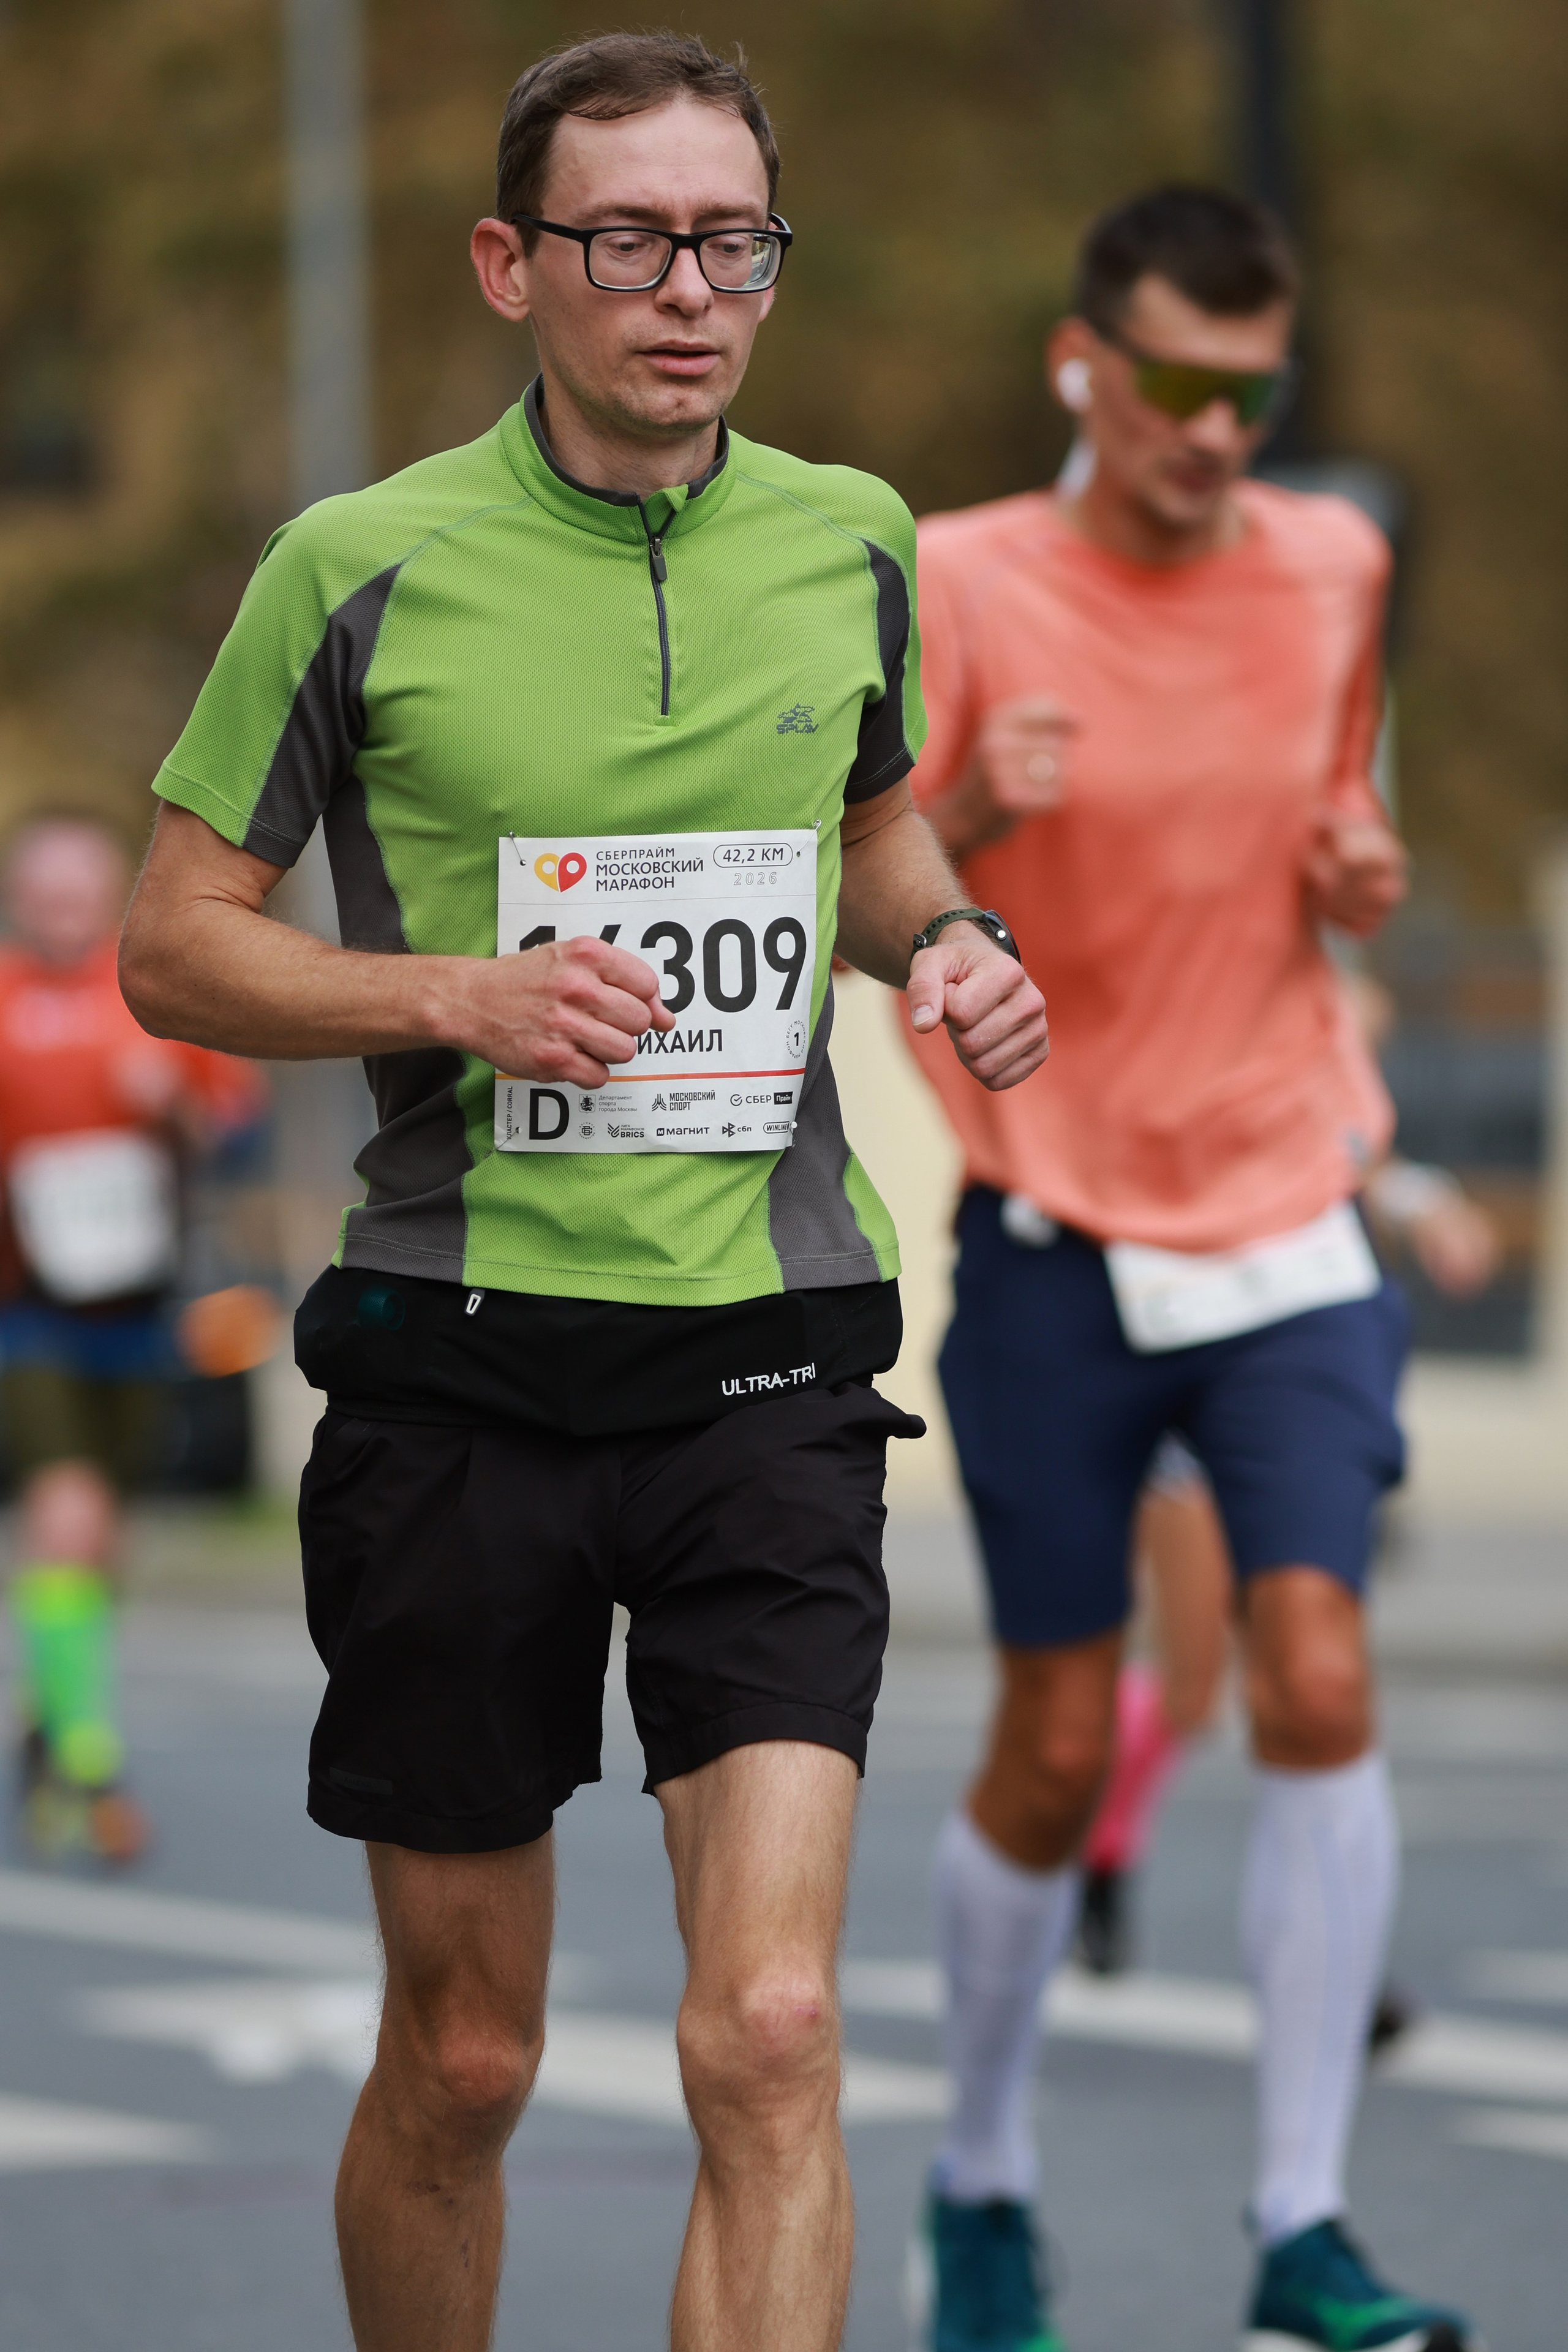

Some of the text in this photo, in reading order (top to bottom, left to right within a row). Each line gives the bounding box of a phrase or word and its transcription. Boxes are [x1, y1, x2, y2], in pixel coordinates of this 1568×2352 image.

[597, 846, 674, 861] СБЕРПРАЙМ
[723, 848, 755, 864] 42,2
[597, 857, 703, 876] МОСКОВСКИЙ
[597, 876, 674, 892] МАРАФОН
[733, 872, 777, 886] 2026
[519, 917, 807, 1014] 309
[637, 1029, 722, 1055] ИХАИЛ
[794, 1032, 799, 1046] 1
[669, 1090, 715, 1101] МОСКОВСКИЙ
[745, 1095, 791, 1104] СБЕР Прайм
[529, 1088, 570, 1140] D
[669, 1102, 691, 1111] СПОРТ
[666, 1127, 710, 1136] магнит
